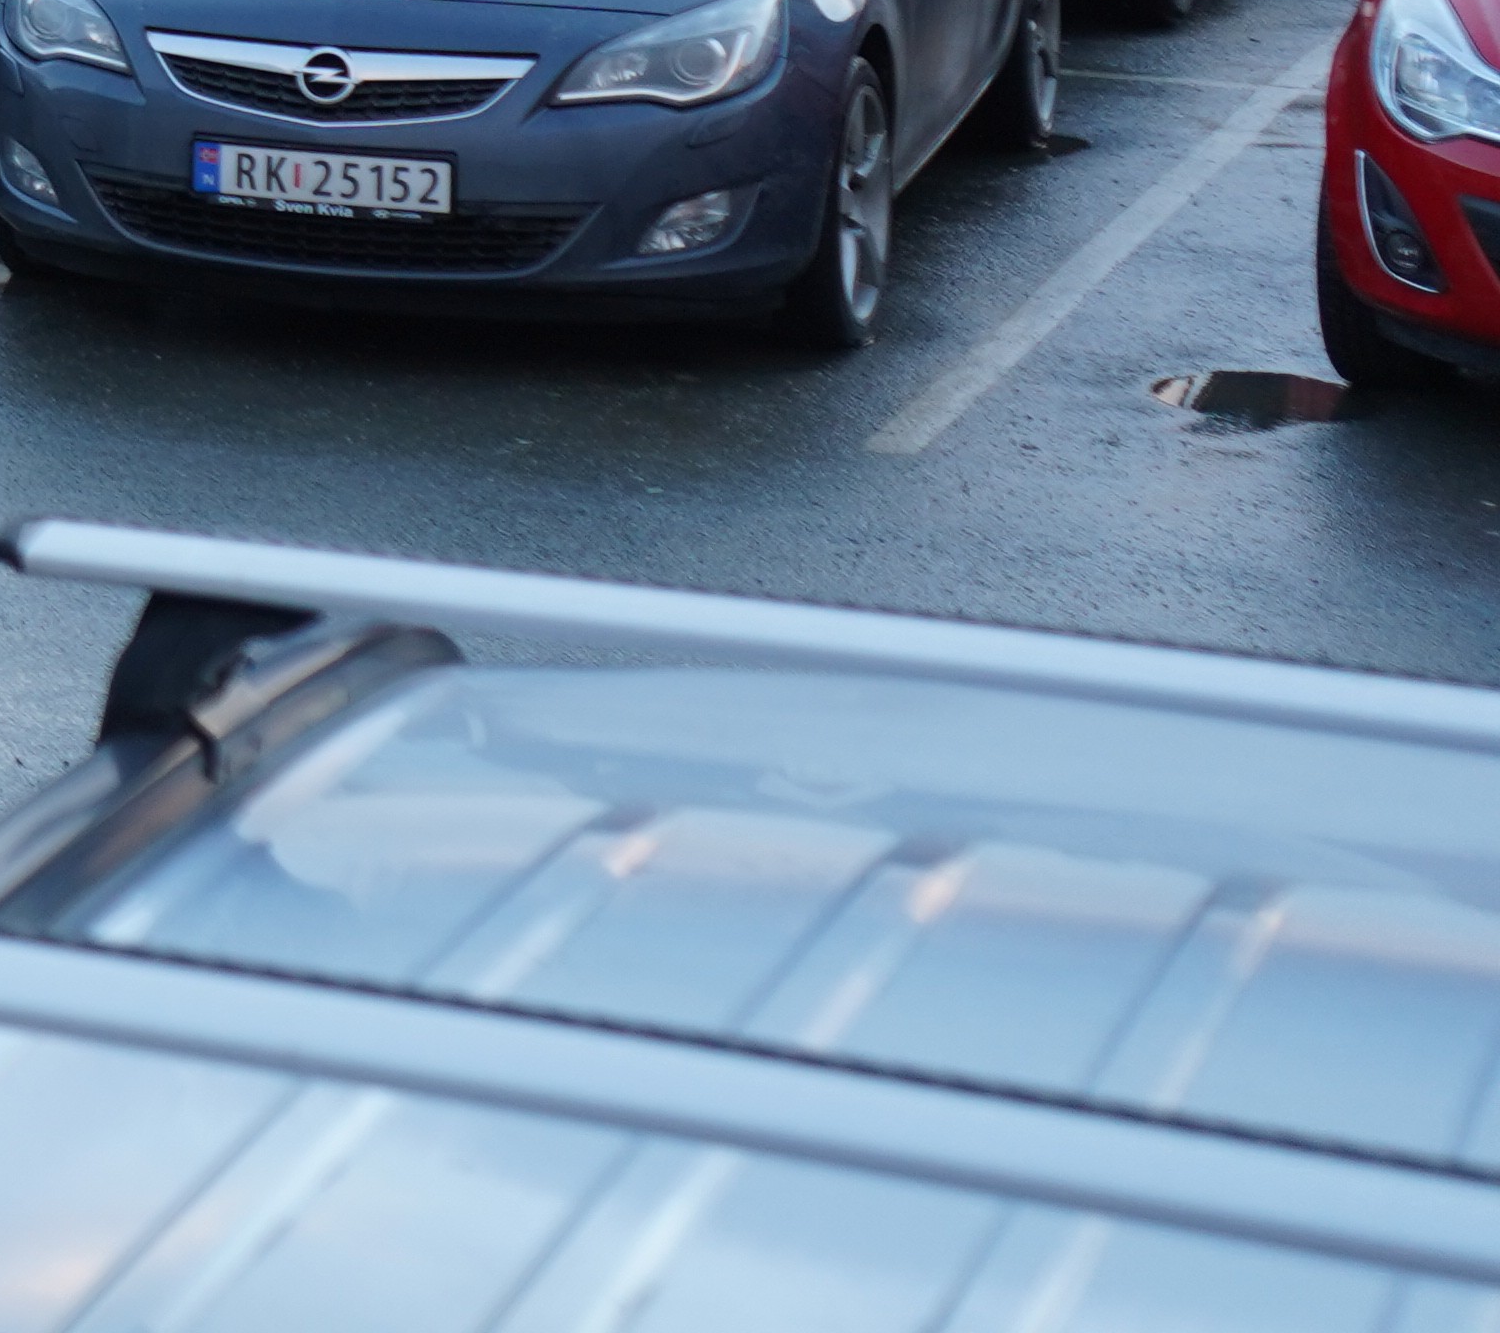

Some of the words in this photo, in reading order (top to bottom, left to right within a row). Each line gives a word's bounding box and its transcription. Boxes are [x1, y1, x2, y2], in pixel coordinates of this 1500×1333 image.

[236, 153, 287, 193] RK
[311, 160, 440, 206] 25152
[274, 199, 314, 215] Sven
[317, 202, 354, 219] Kvia
